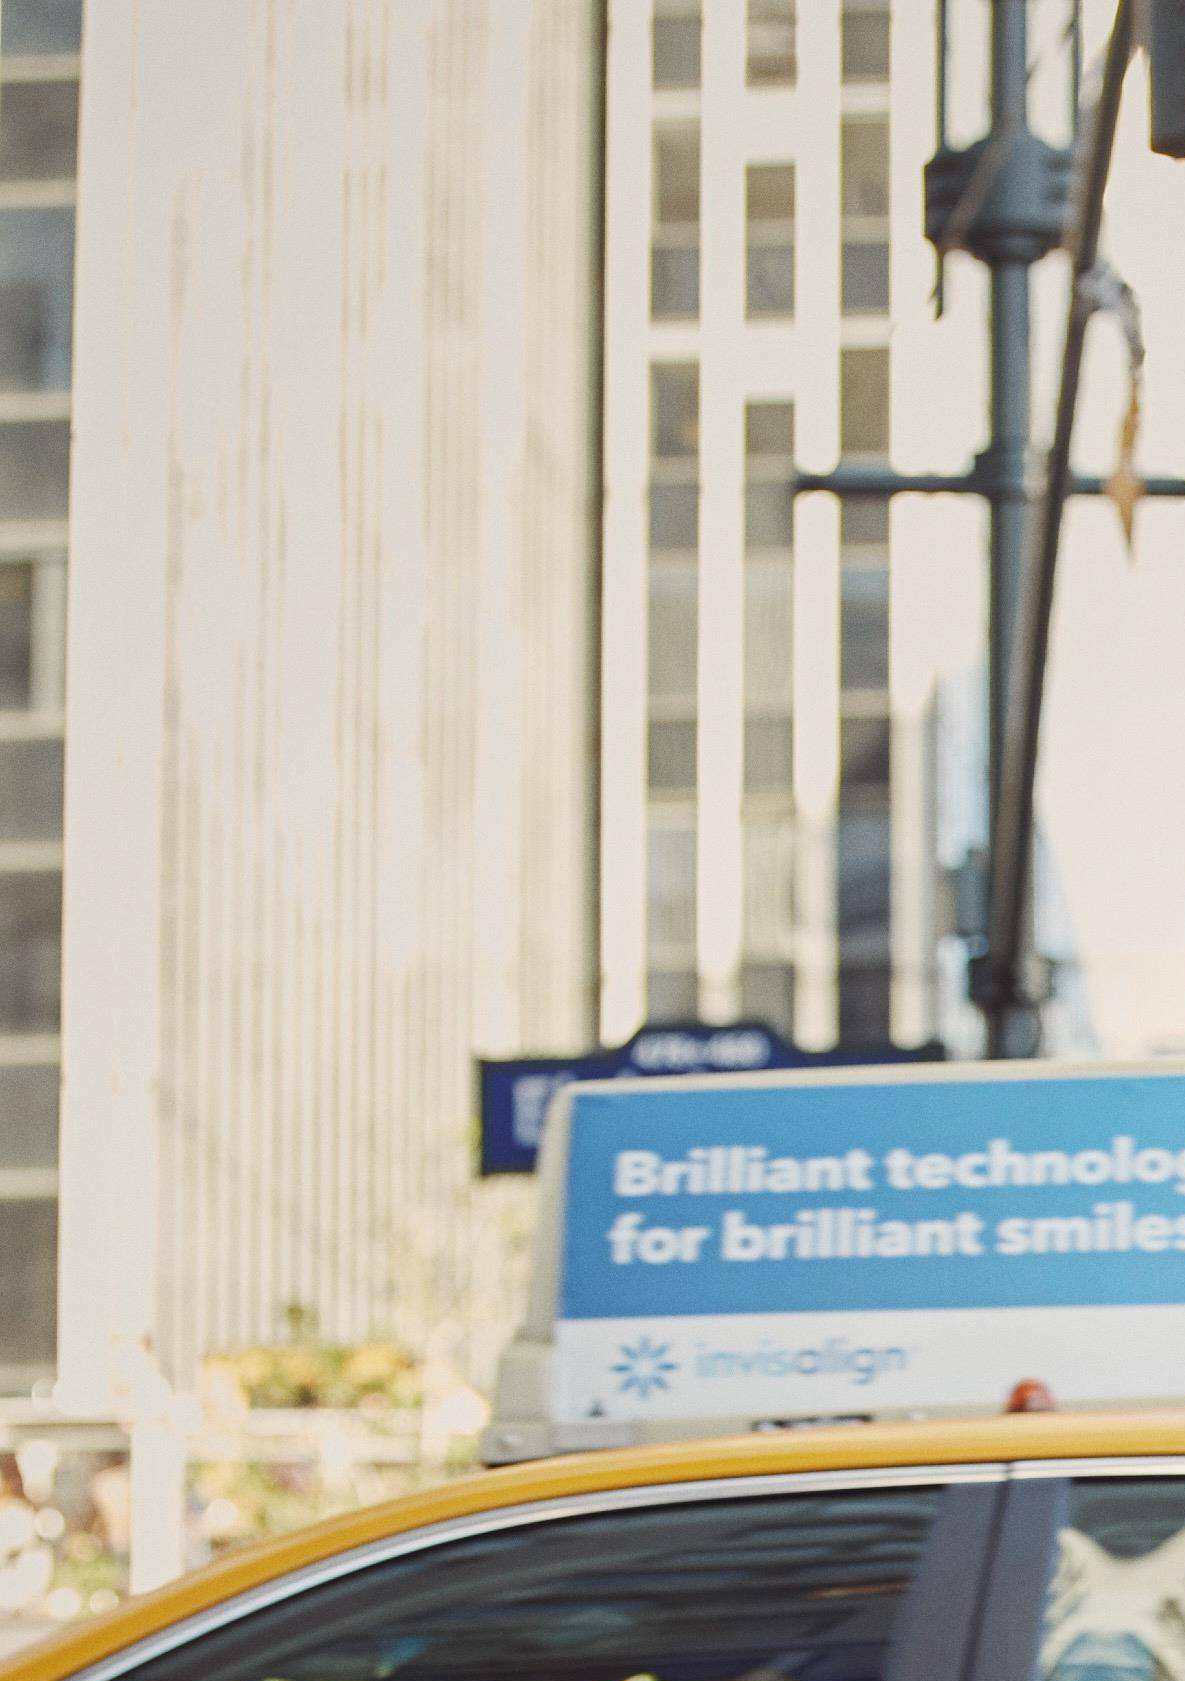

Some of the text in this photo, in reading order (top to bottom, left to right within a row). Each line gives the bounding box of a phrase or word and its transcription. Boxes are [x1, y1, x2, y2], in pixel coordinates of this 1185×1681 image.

[614, 1145, 874, 1196] Brilliant
[608, 1212, 711, 1265] for
[721, 1207, 984, 1262] brilliant
